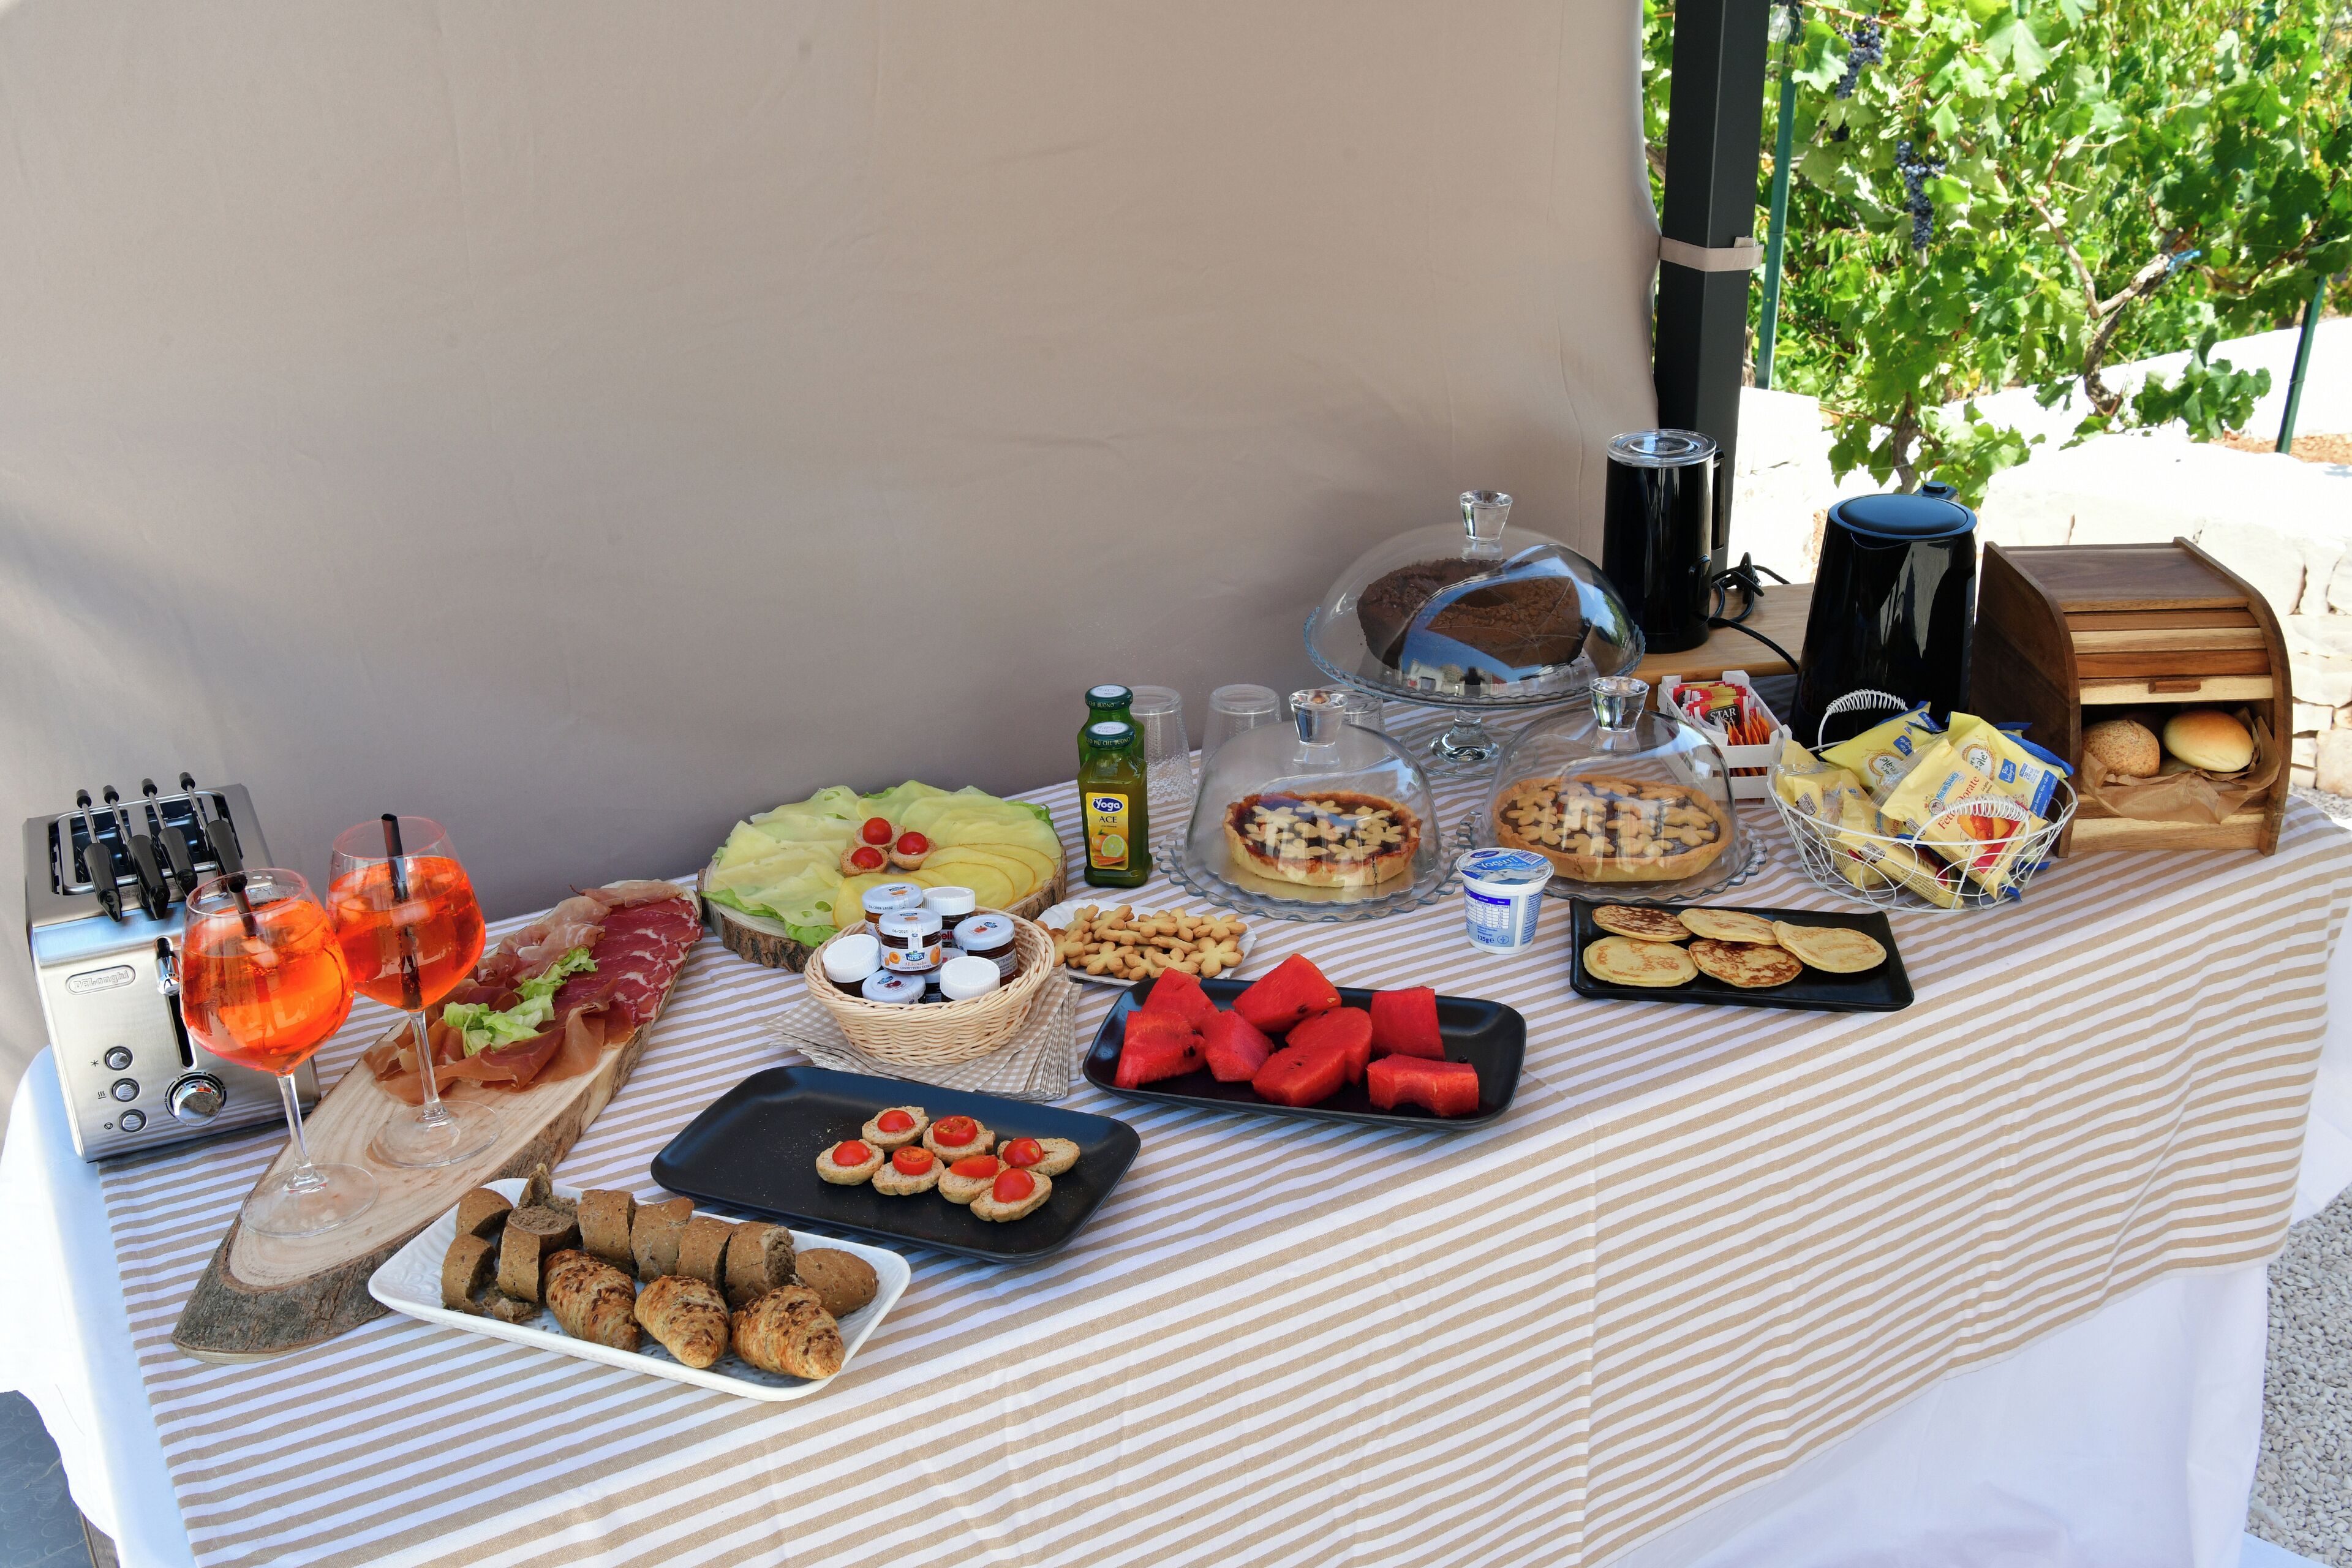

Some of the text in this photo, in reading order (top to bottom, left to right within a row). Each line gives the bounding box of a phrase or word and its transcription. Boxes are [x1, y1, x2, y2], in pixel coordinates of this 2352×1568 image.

[1709, 708, 1736, 721] STAR
[1943, 772, 1959, 787] BIANCO
[1095, 799, 1120, 812] Yoga
[1471, 857, 1518, 869] Yogurt
